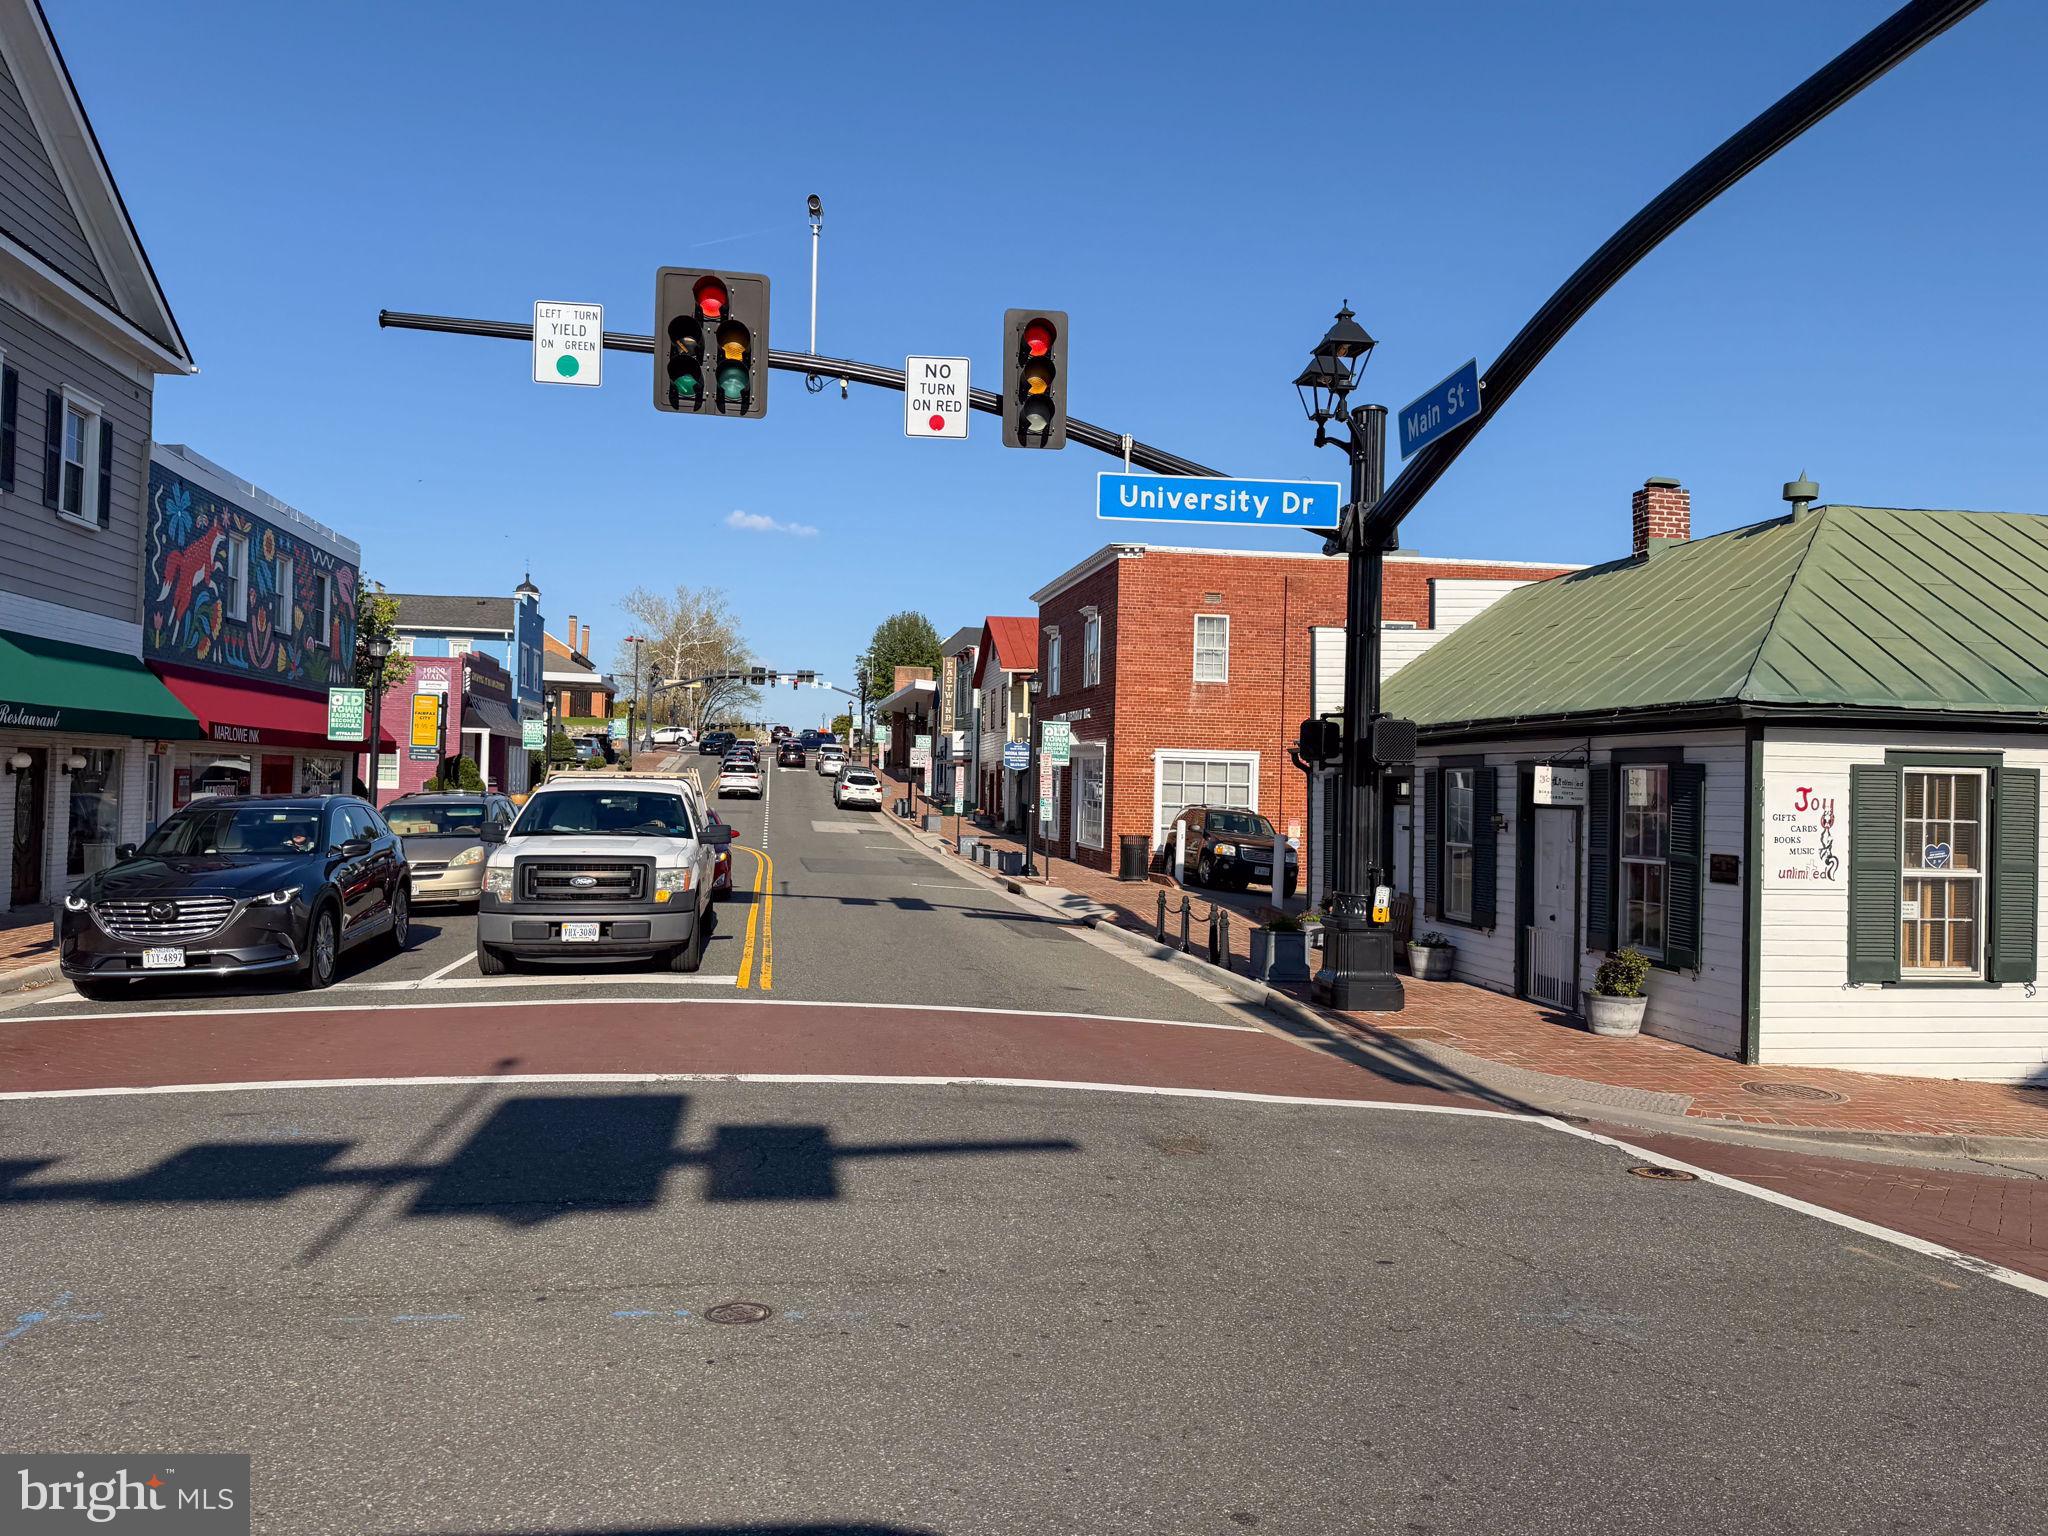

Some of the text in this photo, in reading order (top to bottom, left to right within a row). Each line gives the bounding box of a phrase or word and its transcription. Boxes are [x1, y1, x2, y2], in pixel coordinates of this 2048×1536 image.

[540, 308, 599, 321] LEFT TURN
[551, 323, 587, 337] YIELD
[541, 338, 596, 351] ON GREEN
[925, 363, 952, 379] NO
[920, 382, 955, 396] TURN
[912, 398, 962, 413] ON RED
[1407, 383, 1465, 442] Main St
[1119, 484, 1314, 519] University Dr
[944, 661, 954, 722] EASTWIND
[331, 694, 362, 706] OLD
[0, 704, 60, 727] Restaurant
[331, 705, 362, 714] TOWN
[214, 724, 260, 743] MARLOWE INK
[1045, 726, 1068, 737] OLD
[1772, 813, 1797, 821] GIFTS
[1774, 836, 1801, 844] BOOKS
[1789, 847, 1815, 855] MUSIC
[564, 927, 597, 937] VHX-3080
[146, 953, 183, 963] TYY-4897
